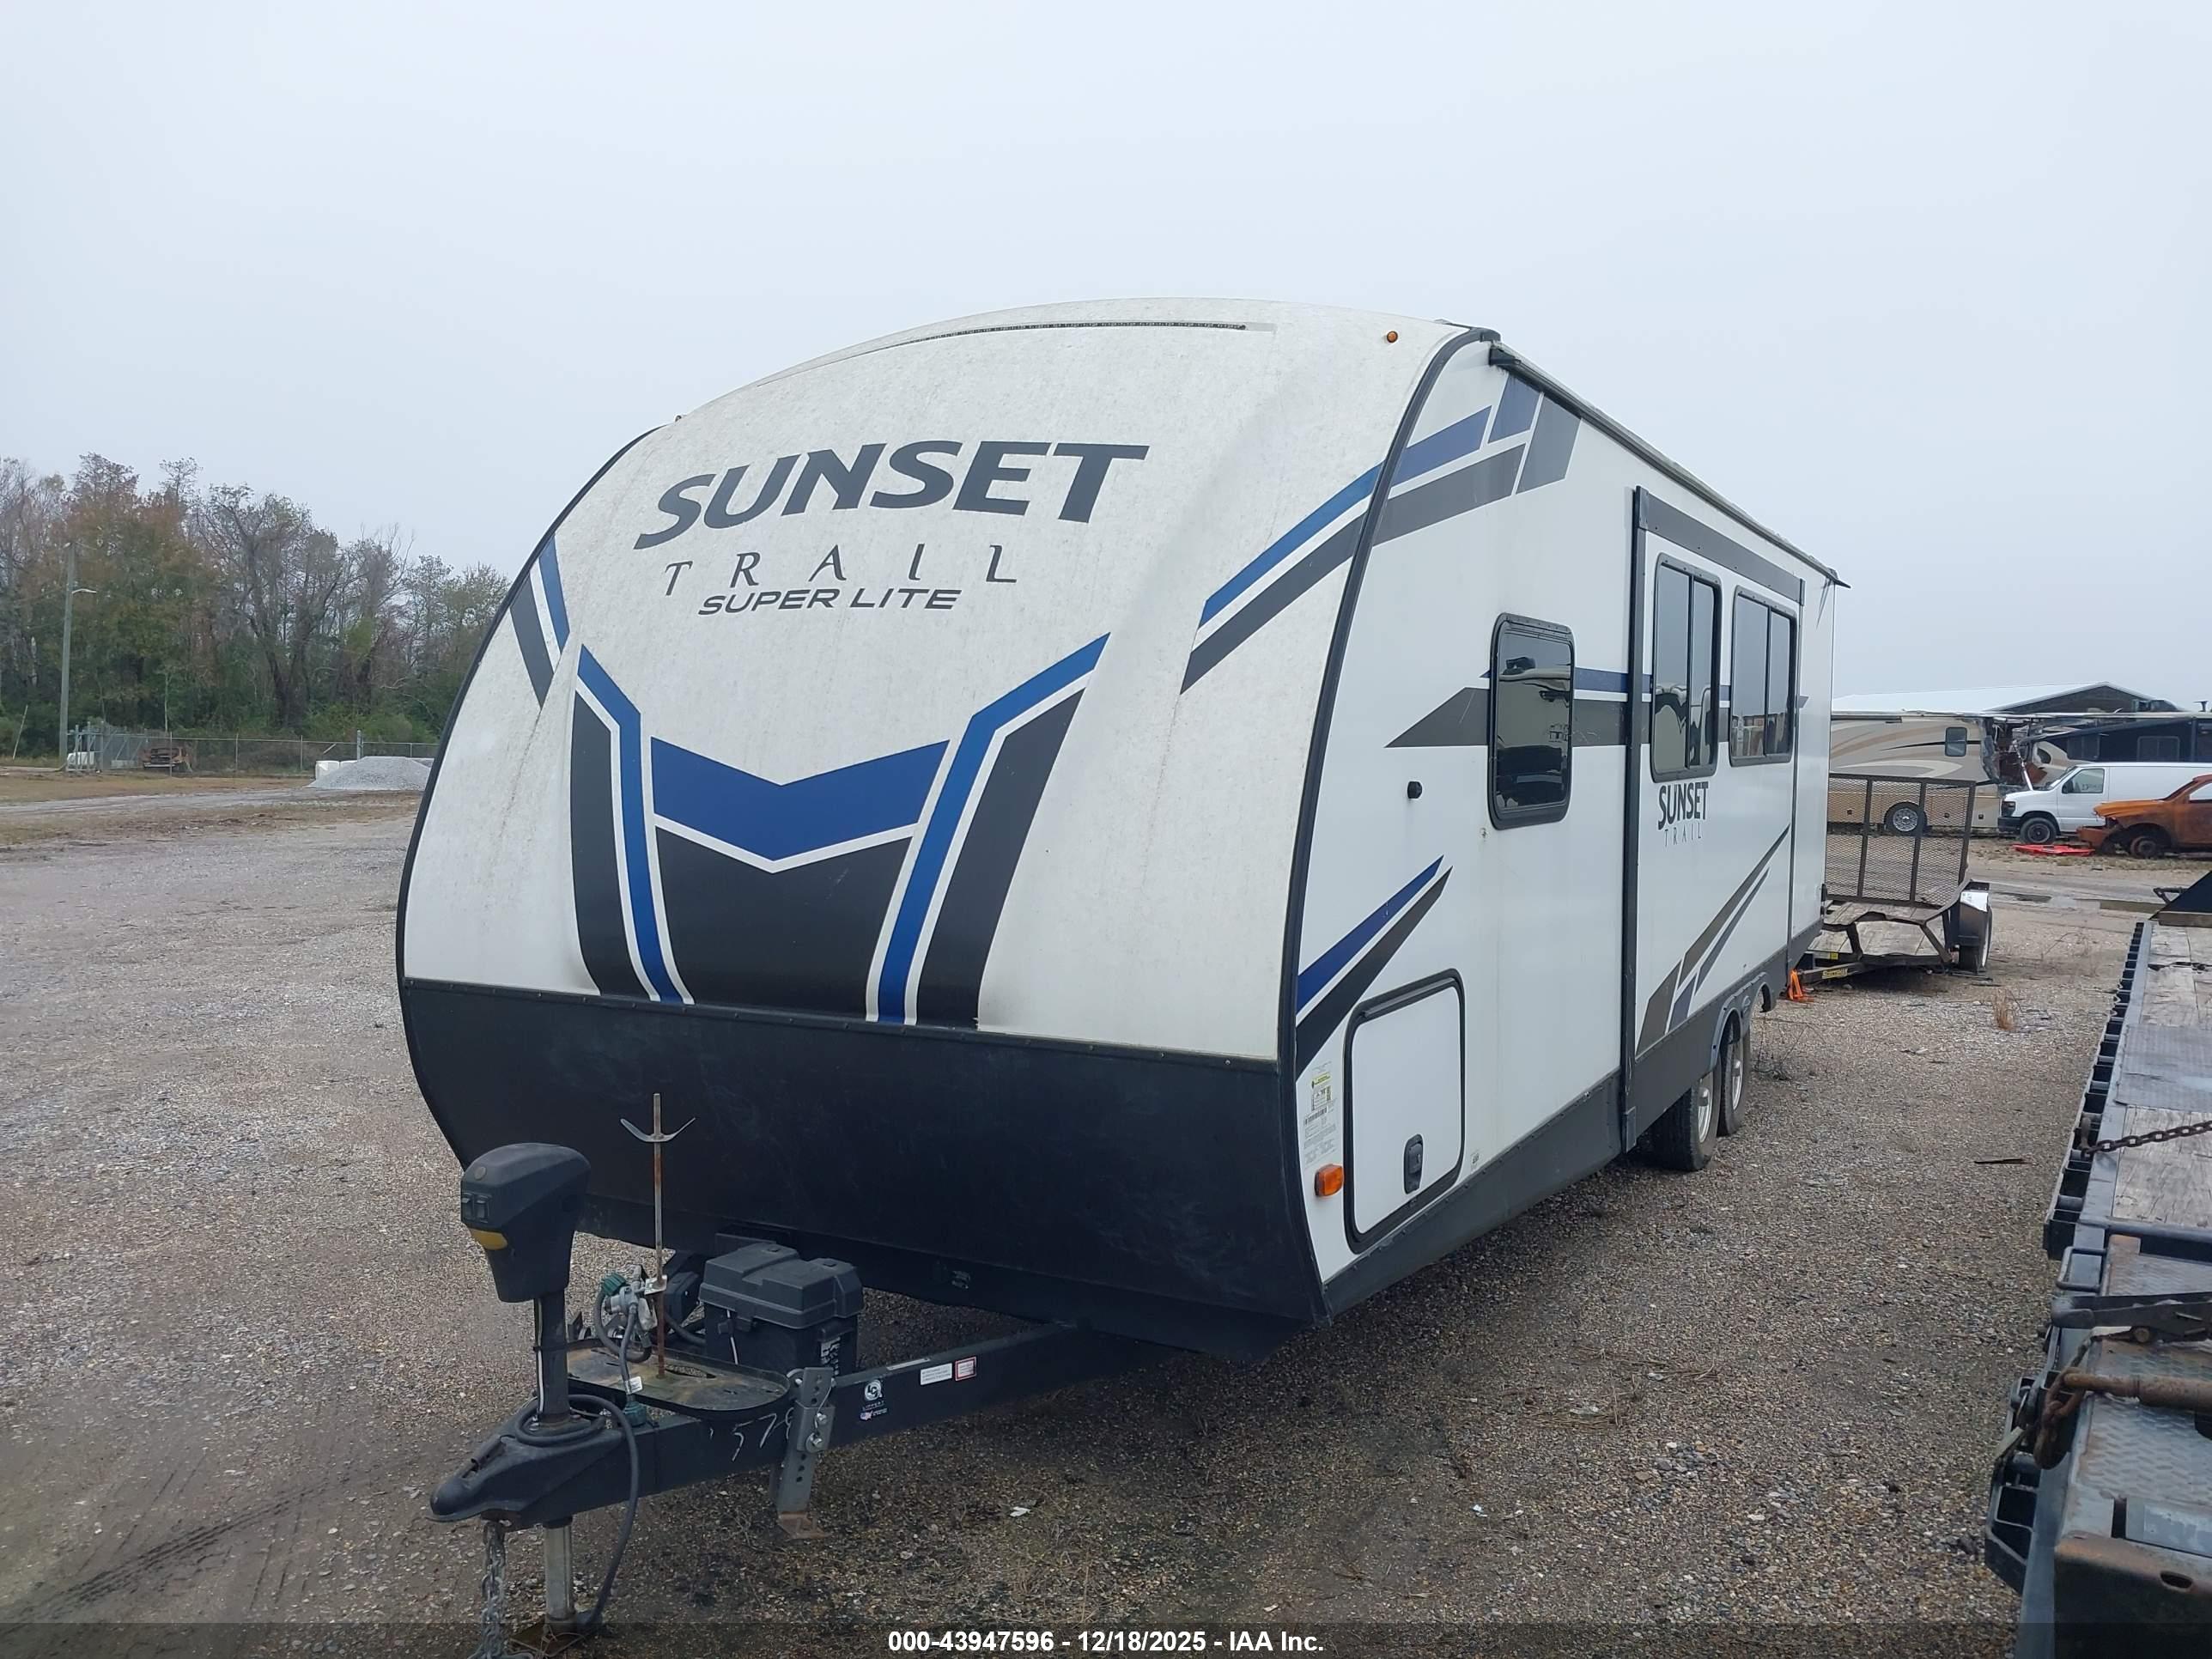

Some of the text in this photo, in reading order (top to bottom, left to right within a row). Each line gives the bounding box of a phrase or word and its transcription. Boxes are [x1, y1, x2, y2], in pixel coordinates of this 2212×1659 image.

[634, 440, 1151, 550] SUNSET
[665, 543, 1018, 596] TRAIL
[698, 587, 963, 616] SUPER LITE
[1657, 781, 1709, 830] SUNSET
[1664, 822, 1702, 848] TRAIL
